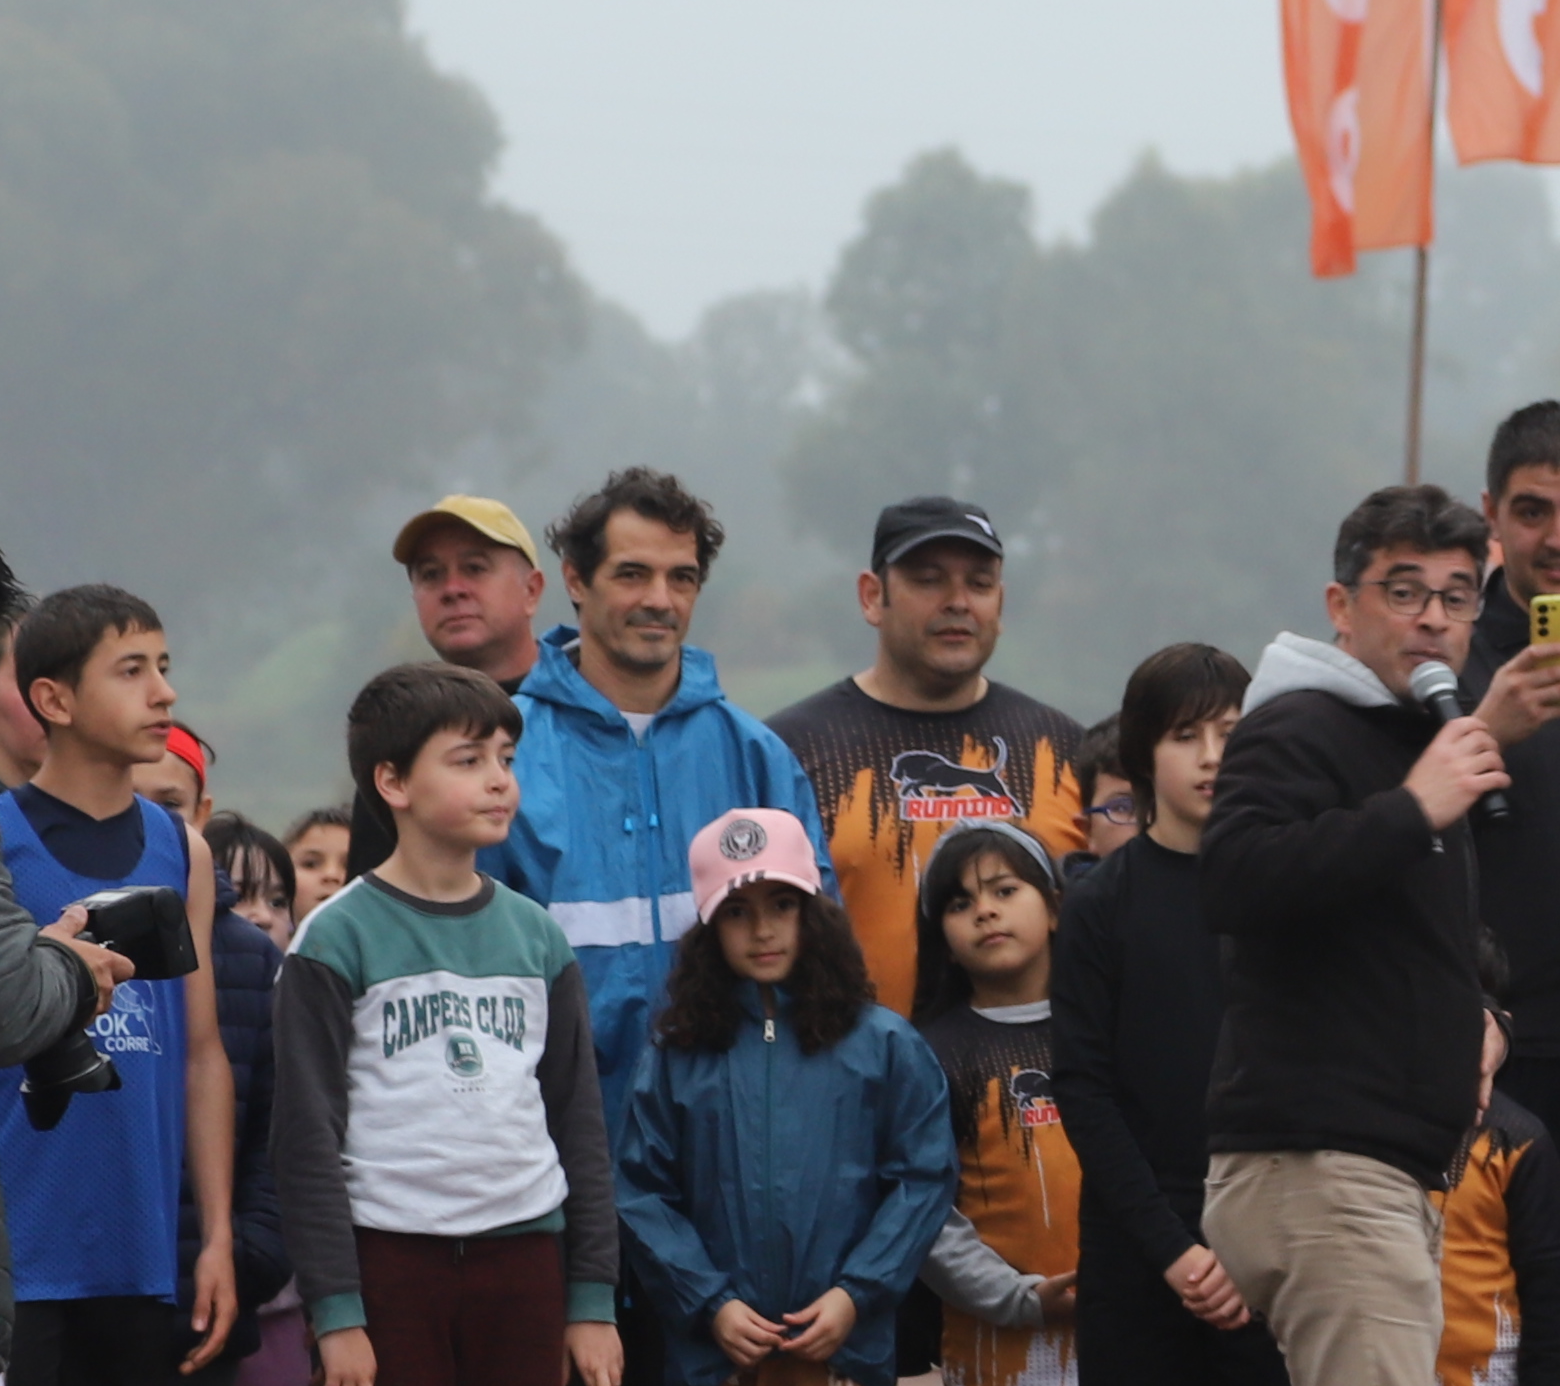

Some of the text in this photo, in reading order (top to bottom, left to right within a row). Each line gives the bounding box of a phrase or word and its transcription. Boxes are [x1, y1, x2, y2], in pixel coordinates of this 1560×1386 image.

[104, 1037, 150, 1052] CORRE
[383, 990, 526, 1059] CAMPERS CLUB
